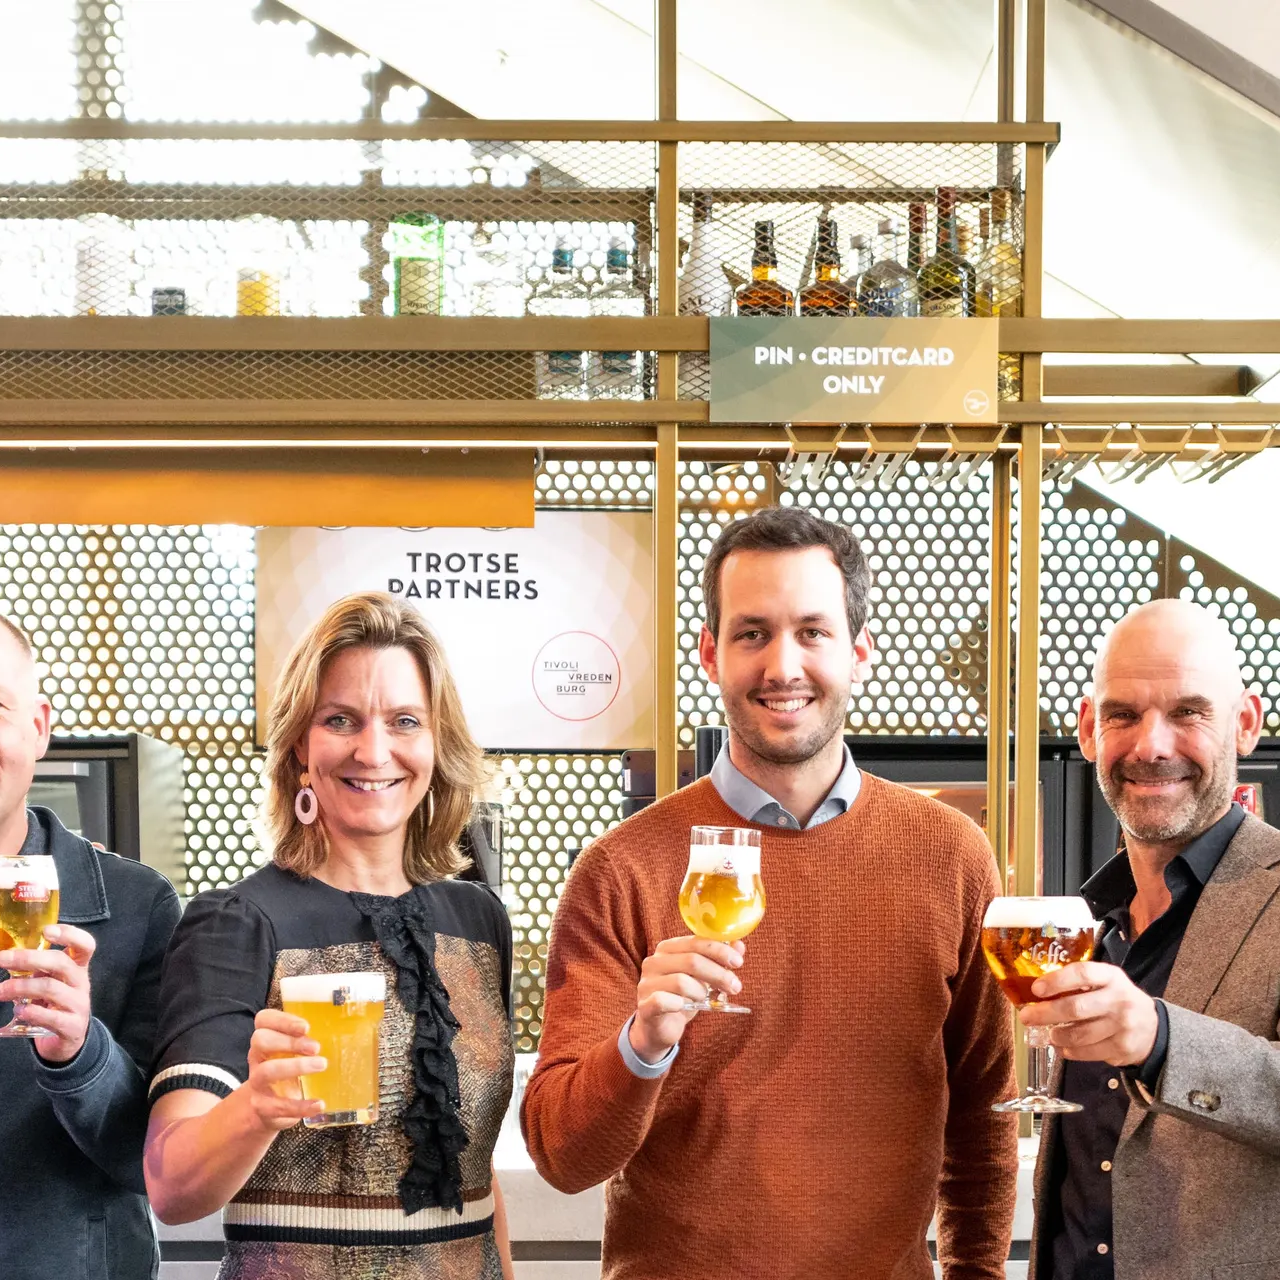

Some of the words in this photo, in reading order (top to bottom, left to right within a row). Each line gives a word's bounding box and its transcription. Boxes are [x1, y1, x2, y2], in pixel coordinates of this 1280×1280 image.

[754, 346, 793, 367] PIN
[811, 346, 954, 367] CREDITCARD
[823, 375, 885, 395] ONLY
[406, 552, 520, 574] TROTSE
[387, 578, 540, 600] PARTNERS
[544, 661, 579, 669] TIVOLI
[568, 673, 612, 681] VREDEN
[556, 685, 586, 693] BURG
